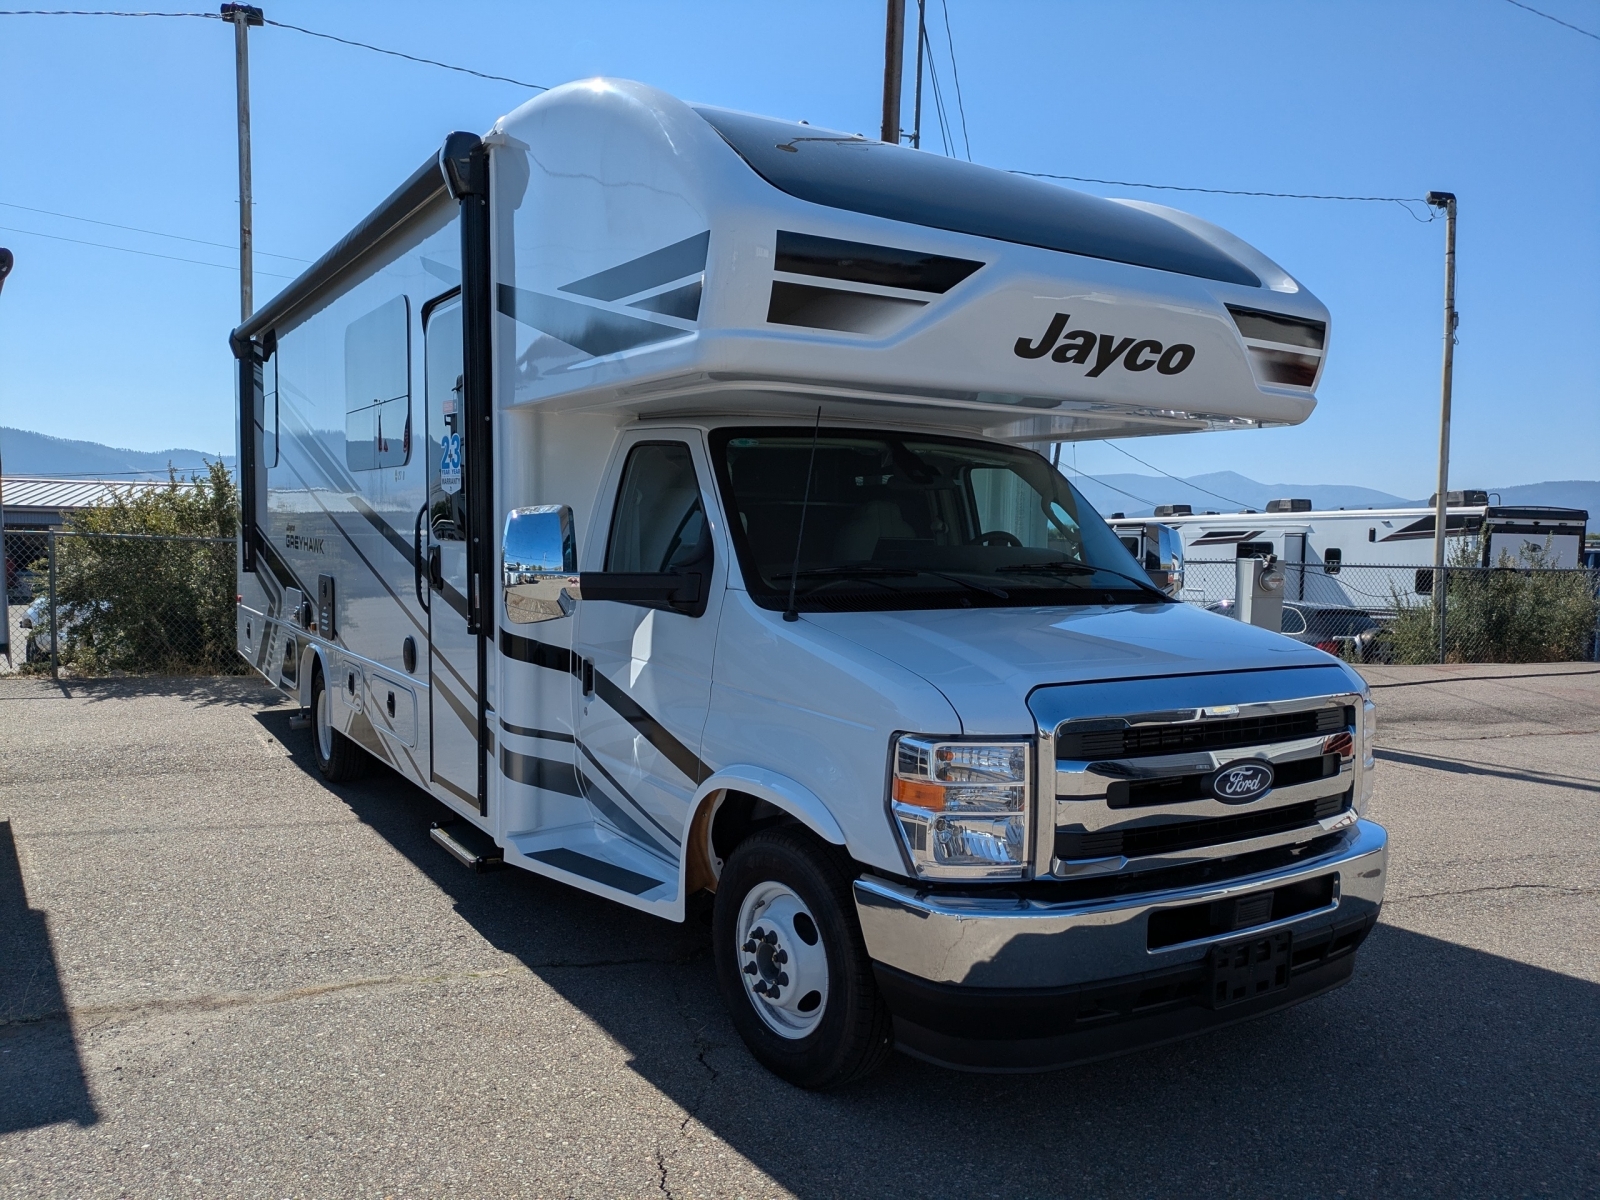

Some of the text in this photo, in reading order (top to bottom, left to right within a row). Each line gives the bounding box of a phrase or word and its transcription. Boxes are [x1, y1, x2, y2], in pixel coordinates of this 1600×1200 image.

[1013, 312, 1196, 378] Jayco
[286, 534, 325, 555] GREYHAWK
[1225, 769, 1262, 794] Ford
